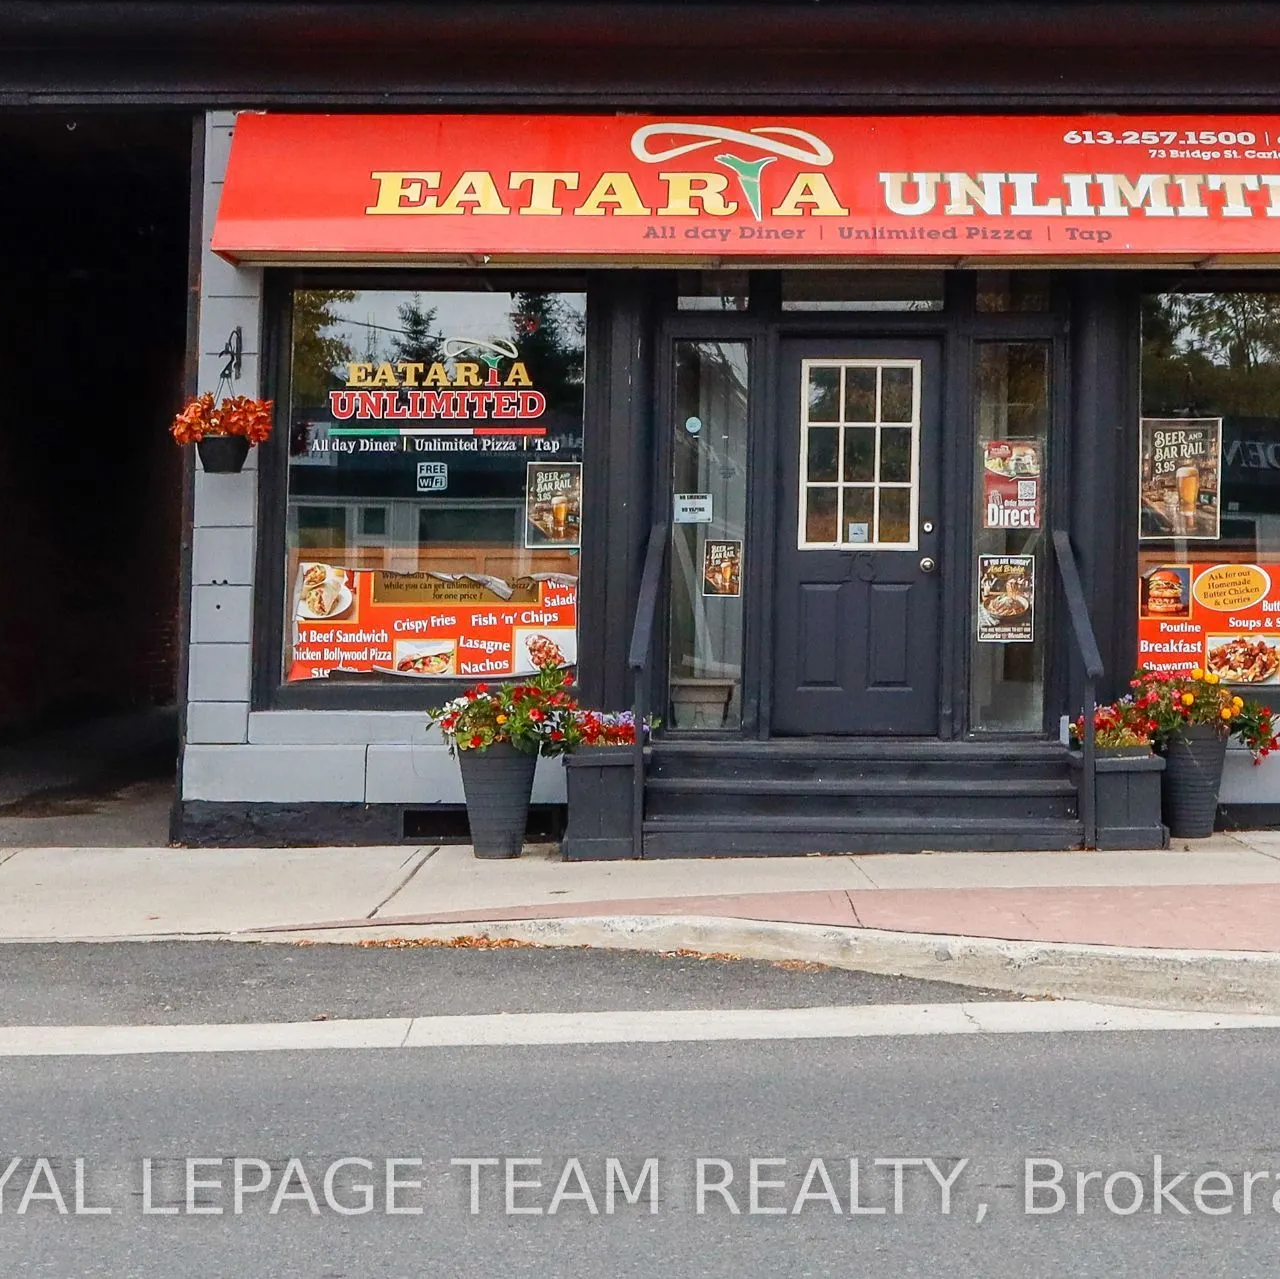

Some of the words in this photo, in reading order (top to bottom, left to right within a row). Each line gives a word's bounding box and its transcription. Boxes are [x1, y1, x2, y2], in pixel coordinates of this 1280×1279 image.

[1063, 130, 1256, 146] 613.257.1500
[1148, 149, 1167, 159] 73
[1170, 148, 1220, 161] Bridge
[1222, 149, 1241, 160] St.
[643, 225, 677, 239] All
[679, 225, 732, 243] day
[738, 225, 805, 240] Diner
[837, 226, 958, 240] Unlimited
[966, 227, 1033, 240] Pizza
[1064, 227, 1113, 242] Tap
[328, 390, 546, 420] UNLIMITED
[311, 438, 330, 452] All
[332, 438, 356, 454] day
[358, 438, 397, 452] Diner
[414, 438, 478, 452] Unlimited
[481, 438, 517, 452] Pizza
[1154, 430, 1188, 448] BEER
[1188, 432, 1203, 441] AND
[534, 438, 560, 455] Tap
[1154, 446, 1178, 462] BAR
[1180, 441, 1206, 459] RAIL
[419, 464, 446, 474] FREE
[1155, 460, 1176, 474] 3.95
[536, 471, 560, 484] BEER
[536, 482, 554, 494] BAR
[554, 478, 572, 491] RAIL
[987, 503, 1036, 527] Direct
[1208, 573, 1223, 581] Ask
[1224, 571, 1237, 579] for
[383, 581, 404, 590] while
[405, 583, 418, 591] you
[420, 582, 432, 590] can
[1207, 578, 1251, 590] Homemade
[459, 593, 477, 602] price
[1203, 590, 1227, 600] Butter
[1228, 586, 1260, 598] Chicken
[393, 619, 428, 634] Crispy
[430, 615, 457, 628] Fries
[471, 613, 497, 627] Fish
[520, 610, 559, 626] Chips
[1228, 616, 1261, 630] Soups
[1264, 617, 1273, 628] &
[1160, 622, 1201, 633] Poutine
[310, 629, 334, 643] Beef
[336, 629, 388, 643] Sandwich
[458, 635, 511, 654] Lasagne
[1140, 639, 1202, 653] Breakfast
[323, 647, 368, 663] Bollywood
[370, 648, 392, 661] Pizza
[460, 658, 509, 674] Nachos
[1142, 660, 1199, 672] Shawarma
